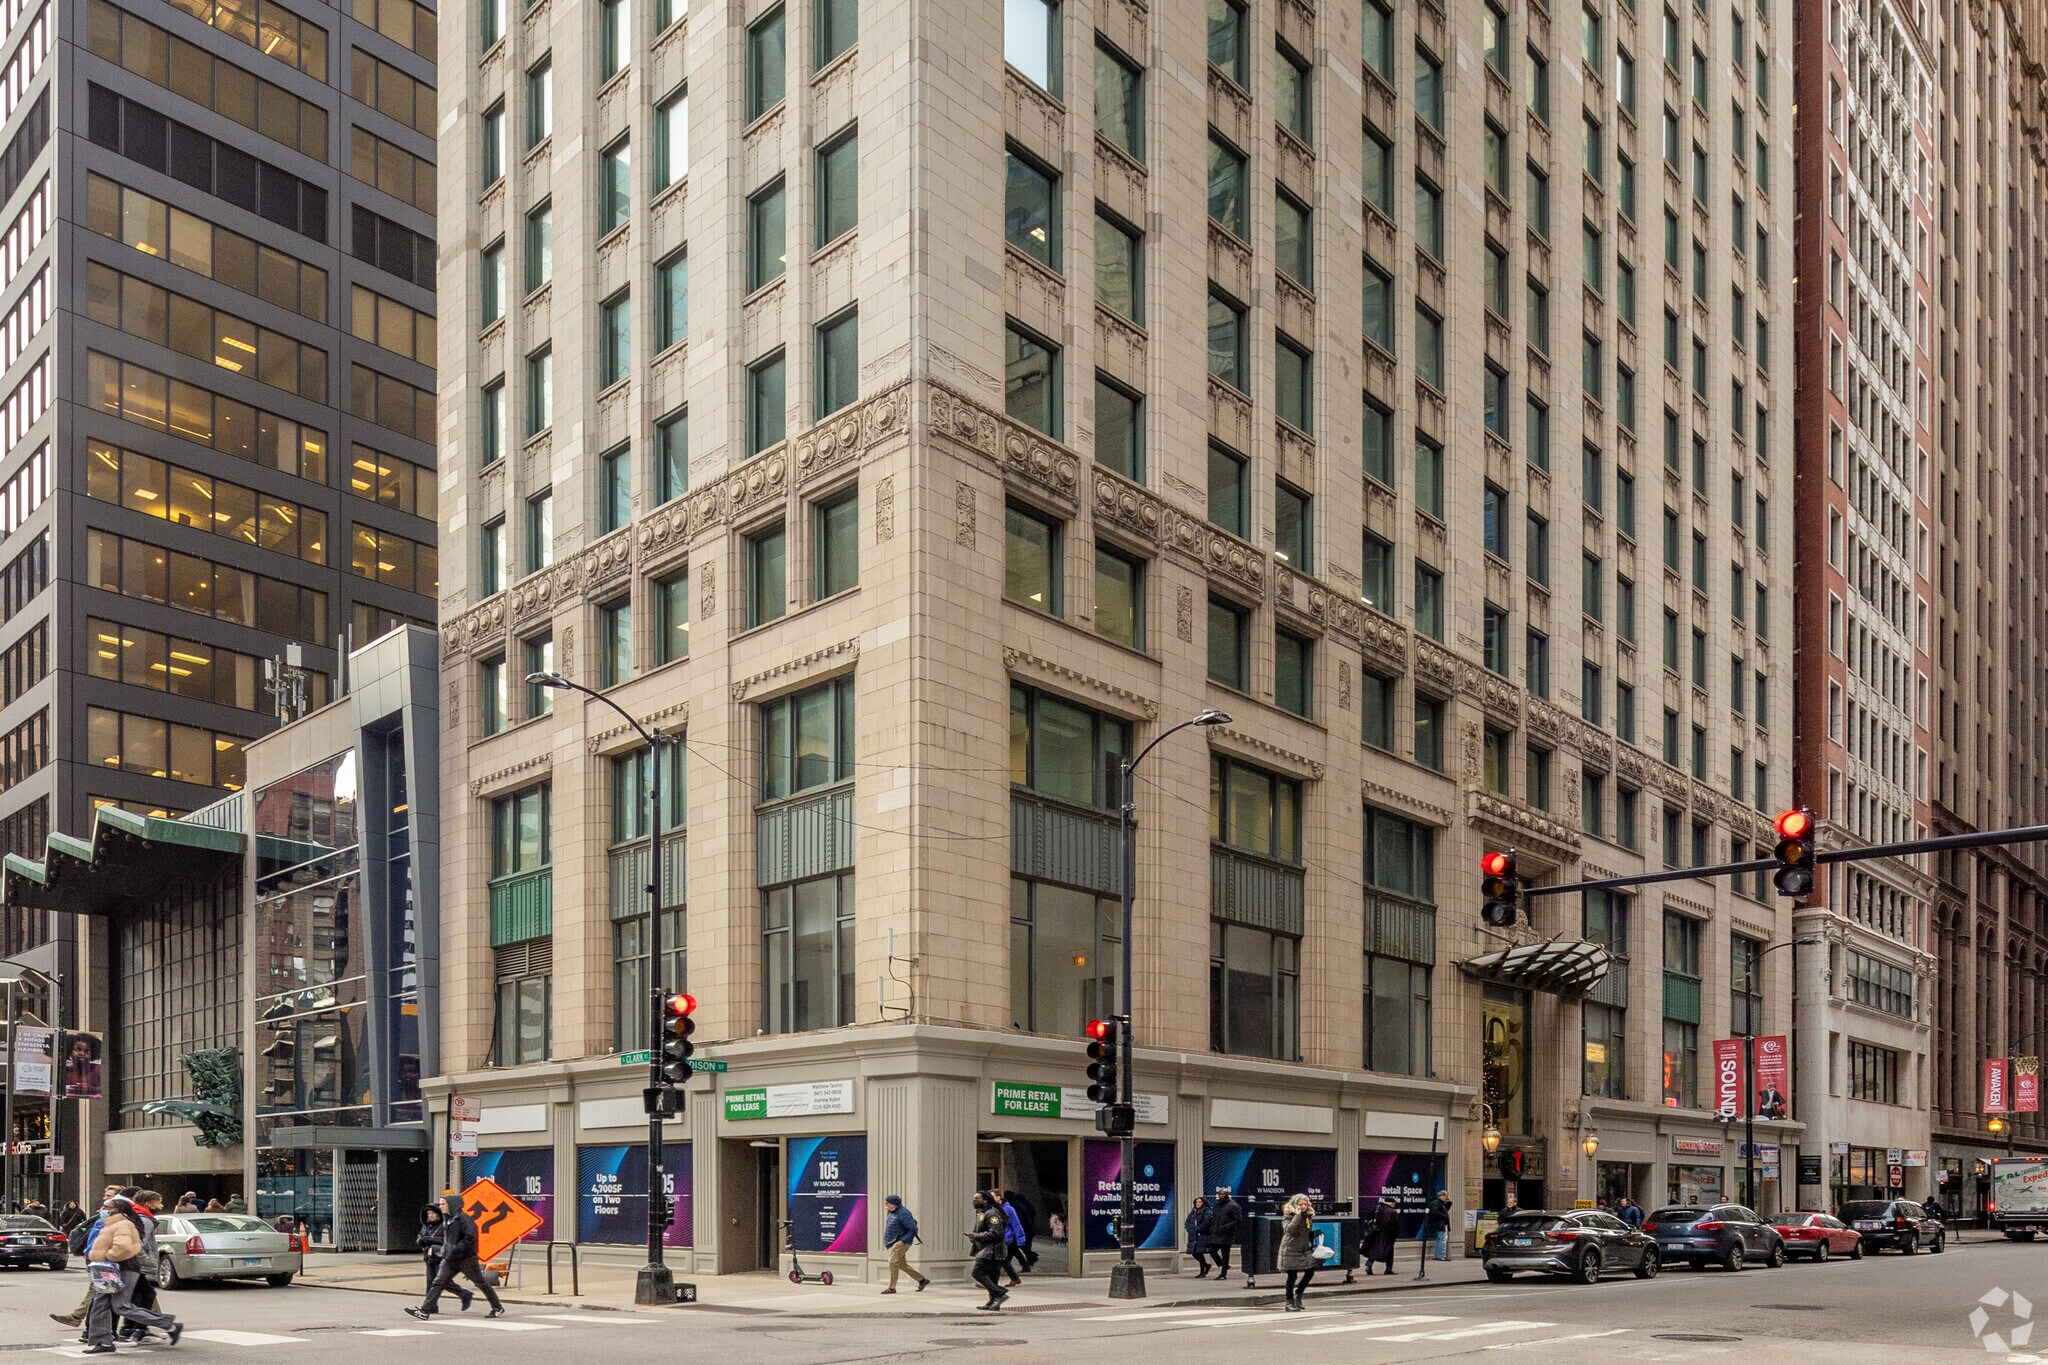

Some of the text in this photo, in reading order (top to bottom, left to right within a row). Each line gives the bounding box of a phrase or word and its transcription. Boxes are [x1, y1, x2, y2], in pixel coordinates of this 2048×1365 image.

[626, 1053, 644, 1064] CLARK
[688, 1060, 716, 1070] DISON
[1721, 1060, 1737, 1118] SOUND
[1990, 1068, 2001, 1106] AWAKEN
[726, 1094, 744, 1103] PRIME
[745, 1093, 766, 1102] RETAIL
[997, 1089, 1026, 1099] PRIME
[1028, 1091, 1058, 1101] RETAIL
[743, 1103, 760, 1111] LEASE
[1004, 1100, 1049, 1112] FOR LEASE
[17, 1141, 32, 1155] Office
[819, 1162, 838, 1180] 105
[596, 1174, 607, 1184] Up
[1262, 1169, 1280, 1186] 105
[525, 1176, 541, 1194] 105
[592, 1184, 622, 1194] 4,700SF
[1098, 1181, 1121, 1190] Reta
[1382, 1186, 1423, 1195] Retail Space
[1093, 1193, 1121, 1201] Availab
[595, 1206, 618, 1214] Floors
